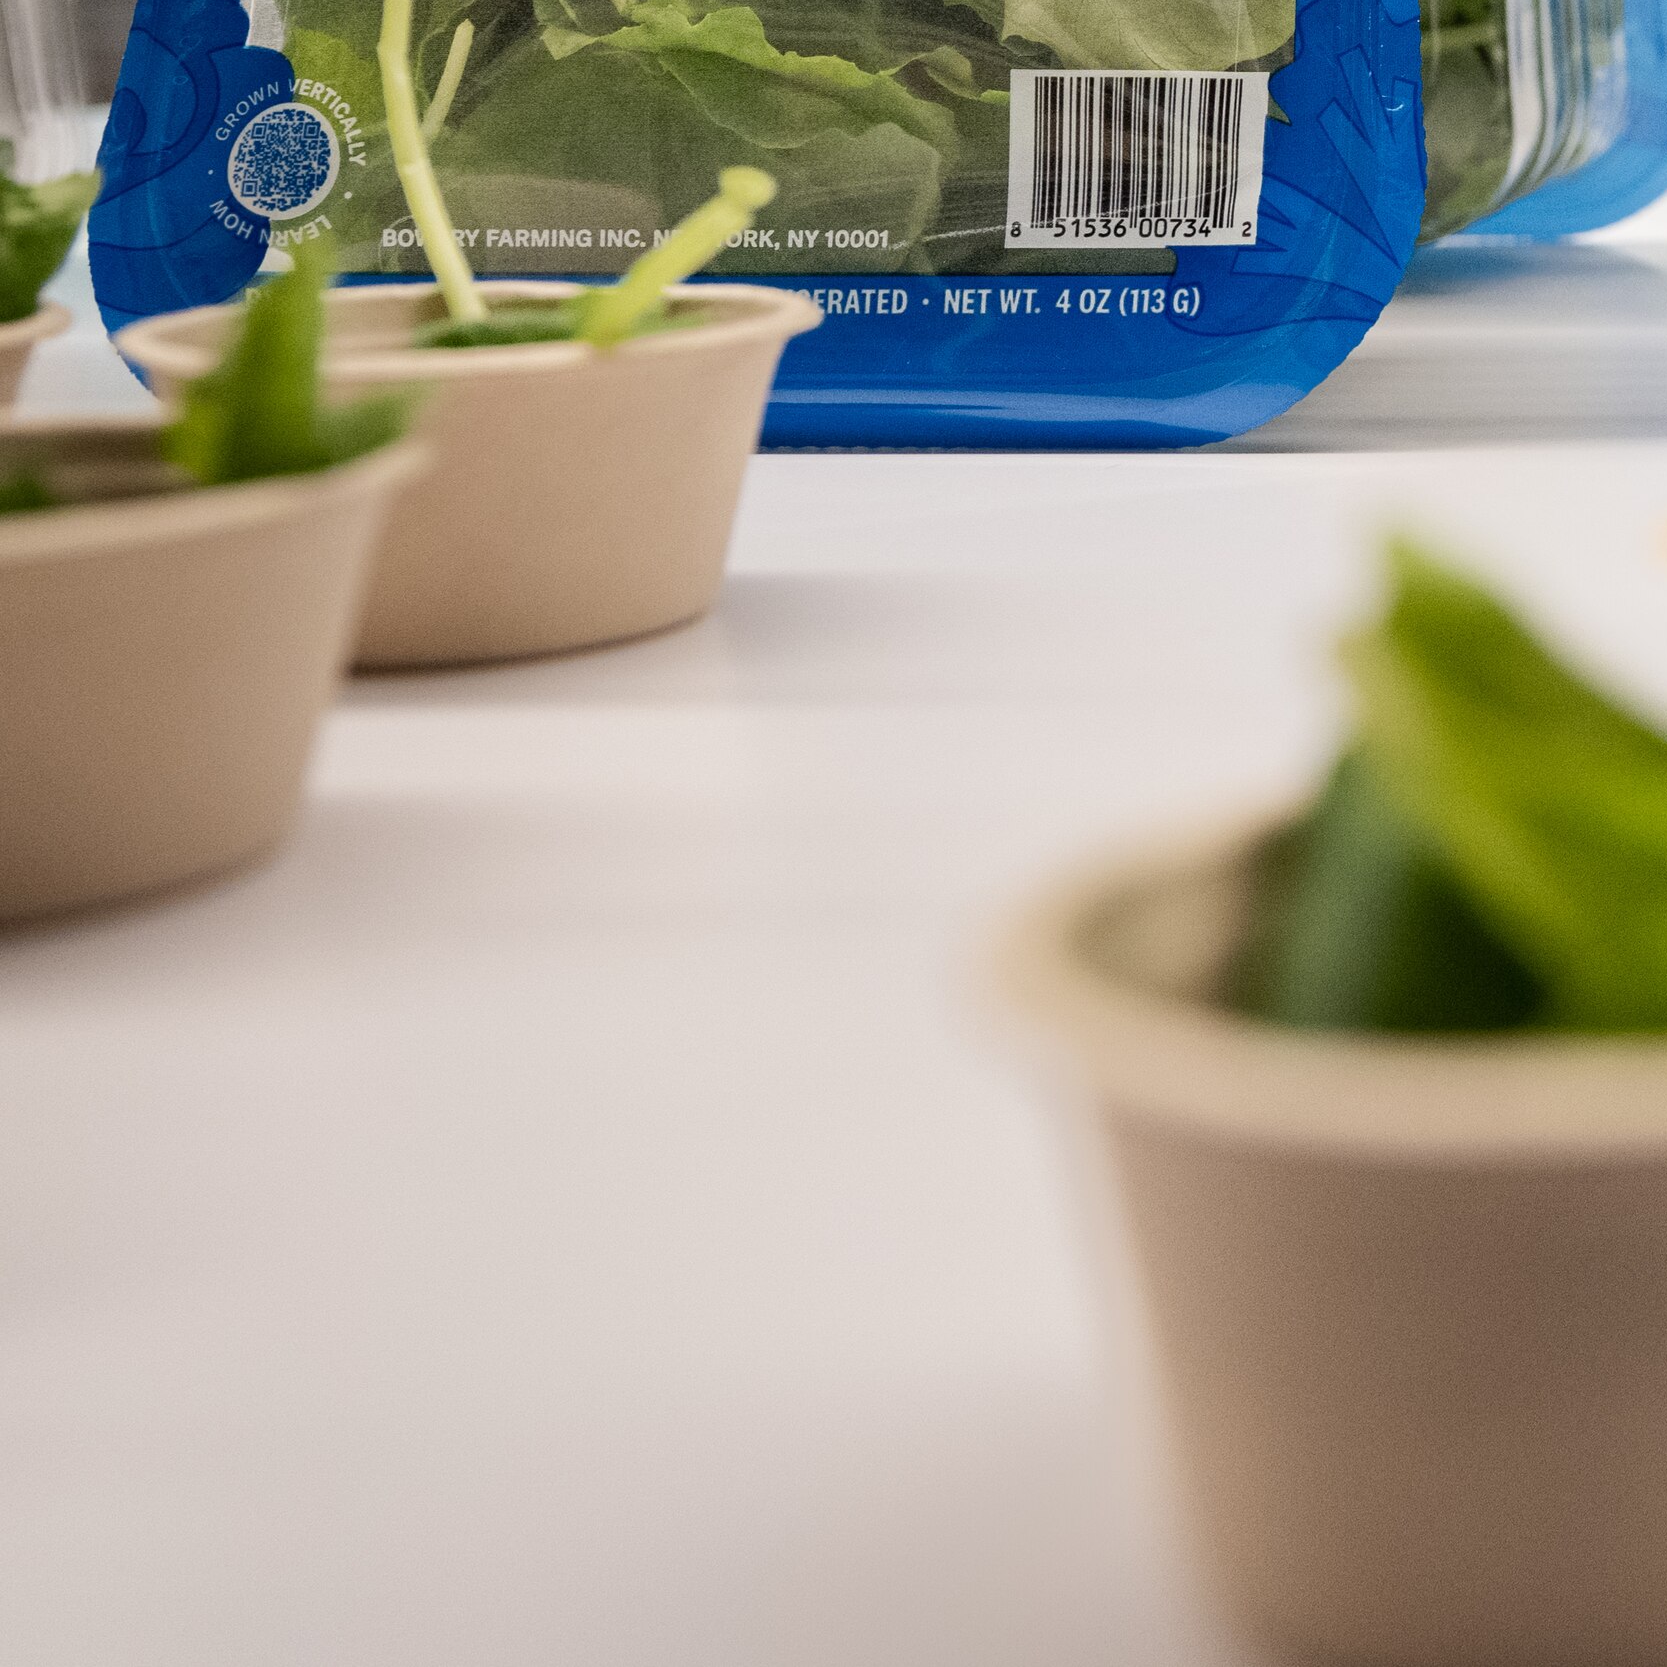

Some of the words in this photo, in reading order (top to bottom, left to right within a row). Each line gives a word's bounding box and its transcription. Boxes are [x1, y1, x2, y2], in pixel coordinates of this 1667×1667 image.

[215, 81, 280, 141] GROWN
[288, 78, 367, 166] VERTICALLY
[209, 199, 254, 239] HOW
[259, 214, 333, 248] LEARN
[1010, 222, 1021, 239] 8
[1054, 219, 1126, 238] 51536
[1138, 219, 1211, 238] 00734
[1242, 222, 1252, 238] 2
[382, 228, 479, 248] BORY
[486, 228, 592, 248] FARMING
[599, 229, 646, 248] INC.
[719, 230, 780, 251] ORK,
[787, 230, 820, 248] NY
[825, 230, 888, 248] 10001
[944, 289, 992, 315] NET
[1000, 289, 1041, 315] WT.
[1056, 289, 1071, 315] 4
[1079, 289, 1110, 315] OZ
[1119, 289, 1166, 317] (113
[1172, 289, 1201, 317] G)
